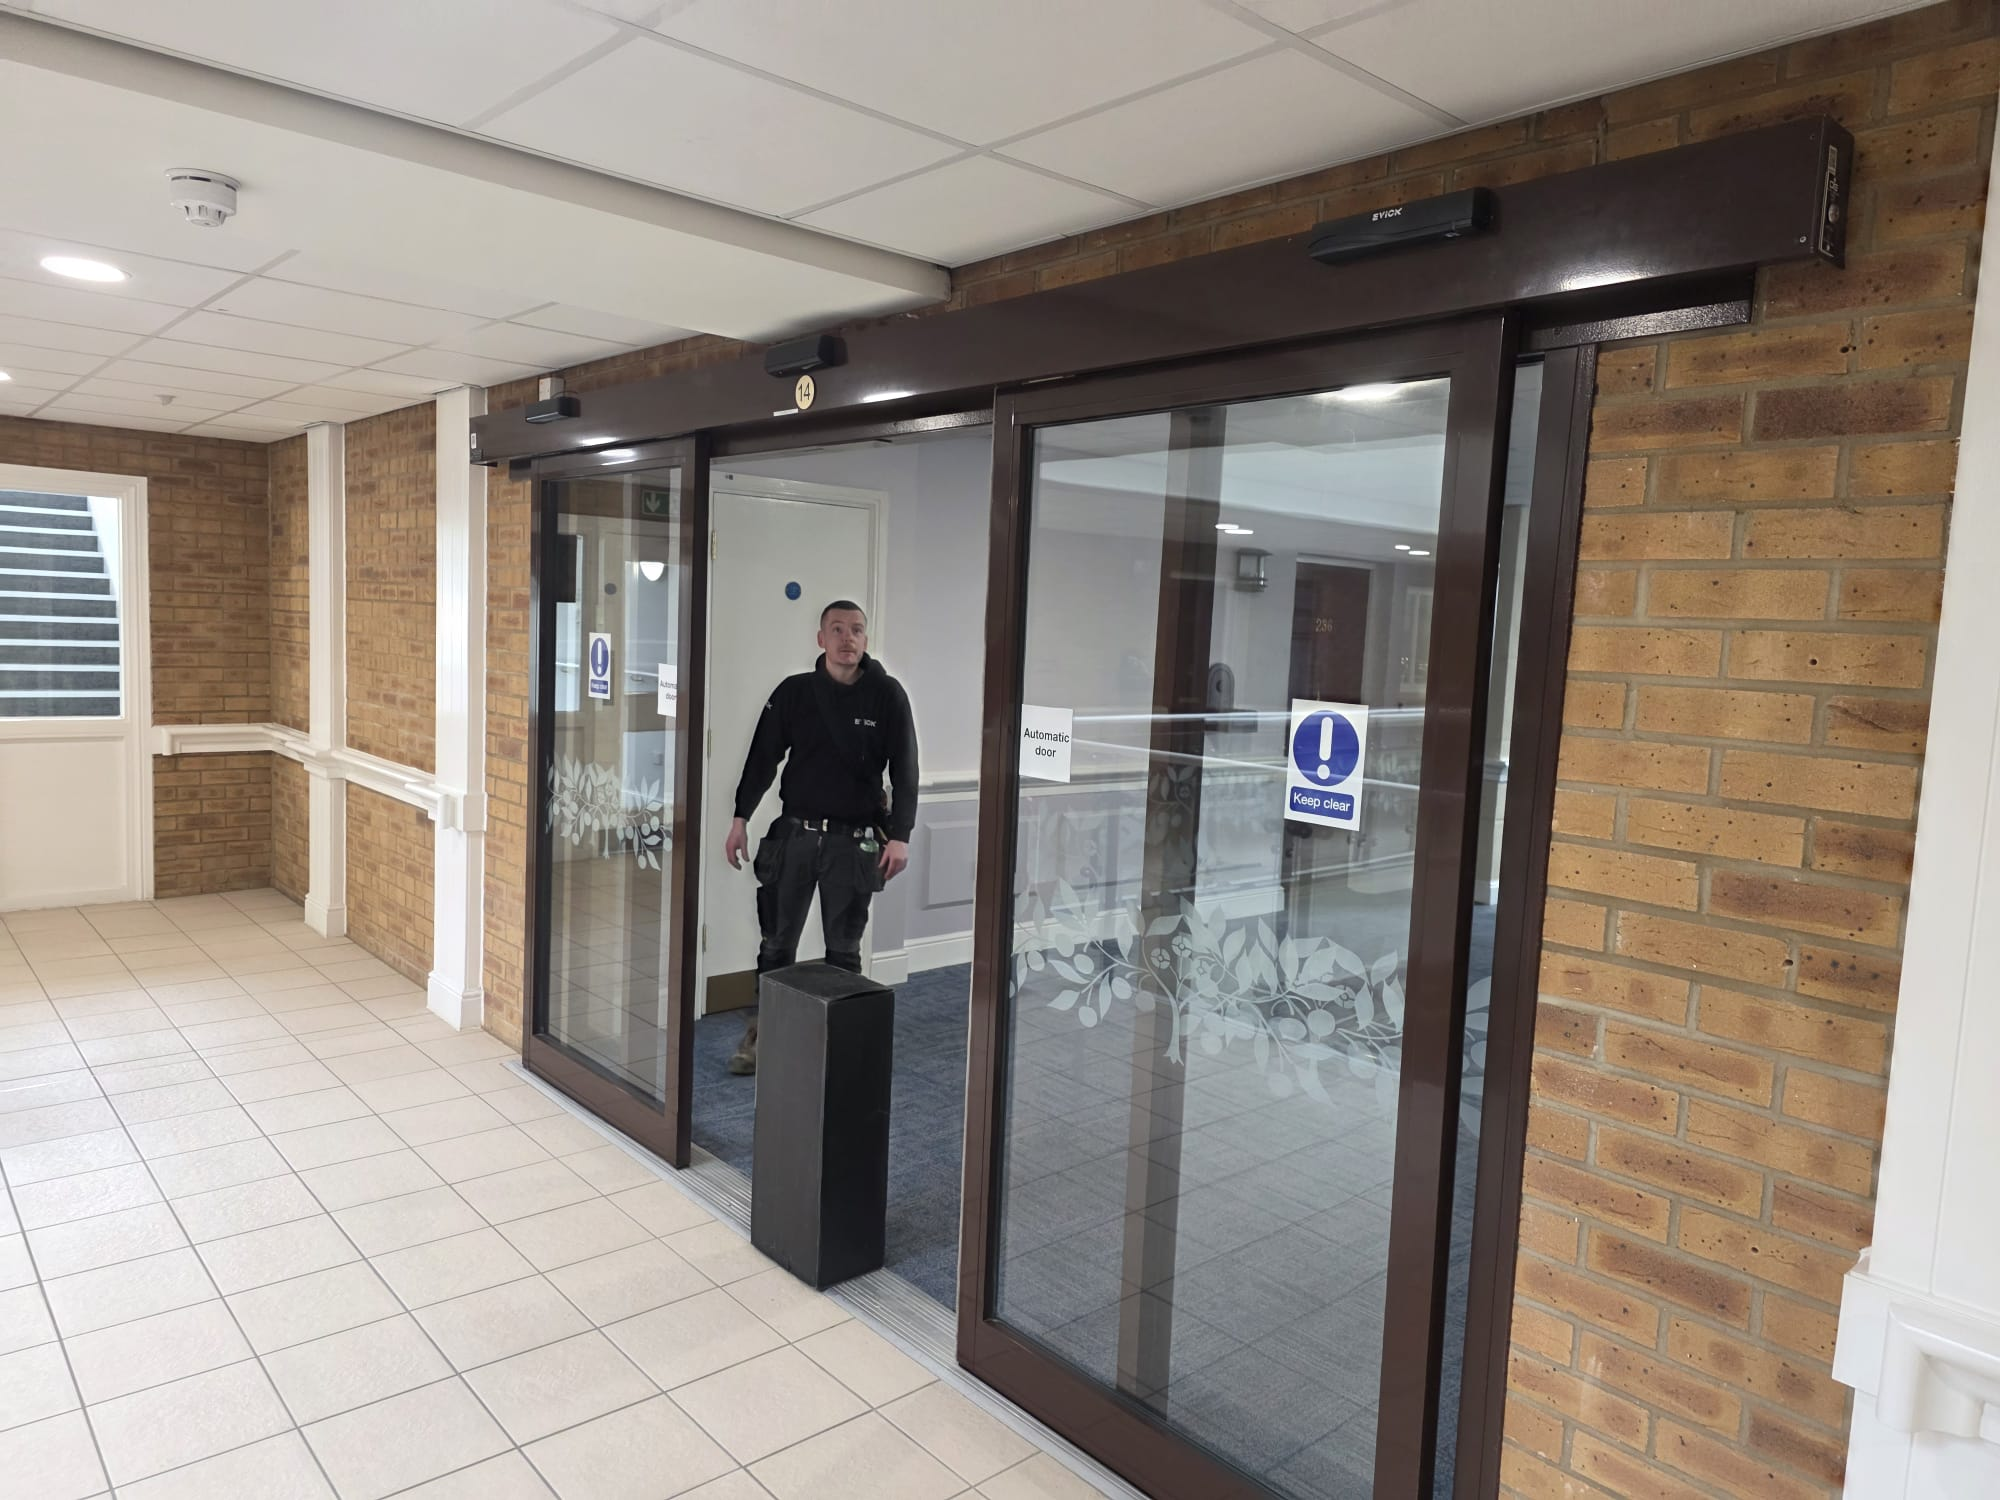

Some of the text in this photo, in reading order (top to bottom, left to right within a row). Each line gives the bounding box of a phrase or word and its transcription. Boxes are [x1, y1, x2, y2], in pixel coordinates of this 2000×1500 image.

[1372, 207, 1403, 221] EVICK
[798, 382, 811, 402] 14
[854, 718, 877, 727] EICK
[1023, 727, 1070, 743] Automatic
[1035, 745, 1057, 758] door
[1293, 791, 1351, 812] Keep clear
